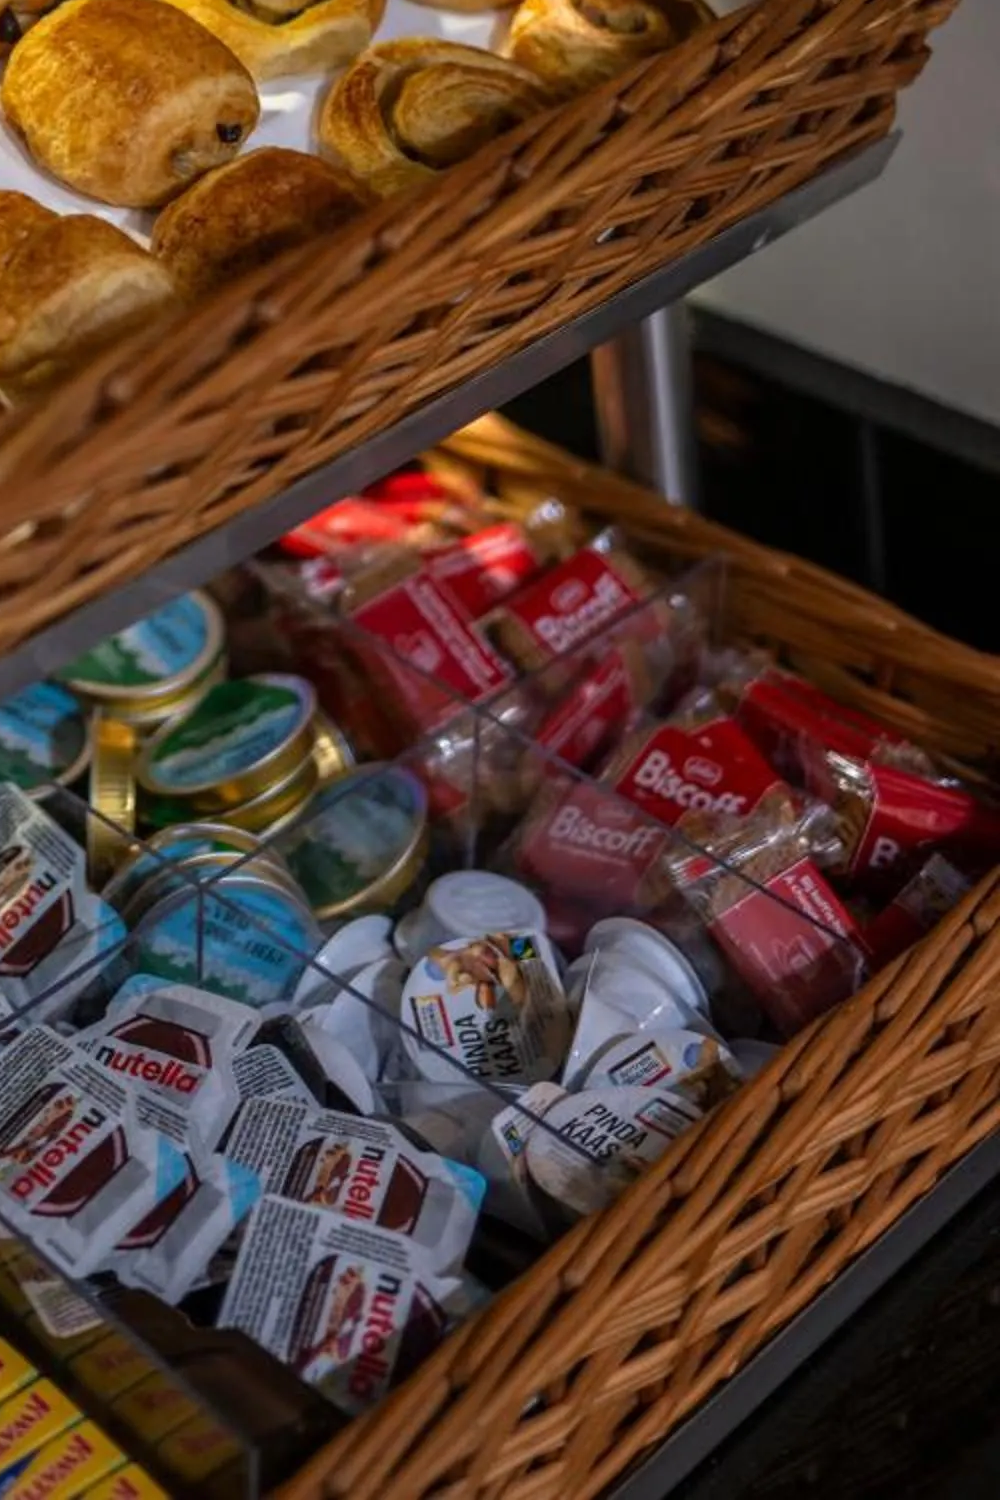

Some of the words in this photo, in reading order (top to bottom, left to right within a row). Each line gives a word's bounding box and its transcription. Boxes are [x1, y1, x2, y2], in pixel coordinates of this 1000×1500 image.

[633, 749, 748, 815] Biscoff
[549, 804, 658, 854] Biscoff
[95, 1045, 200, 1095] nutella
[453, 1013, 493, 1078] PINDA
[484, 1017, 524, 1078] KAAS
[9, 1107, 108, 1199] nutella
[557, 1116, 621, 1160] KAAS
[583, 1102, 650, 1150] PINDA
[344, 1145, 387, 1220] nutell
[14, 1432, 94, 1500] KWATT
